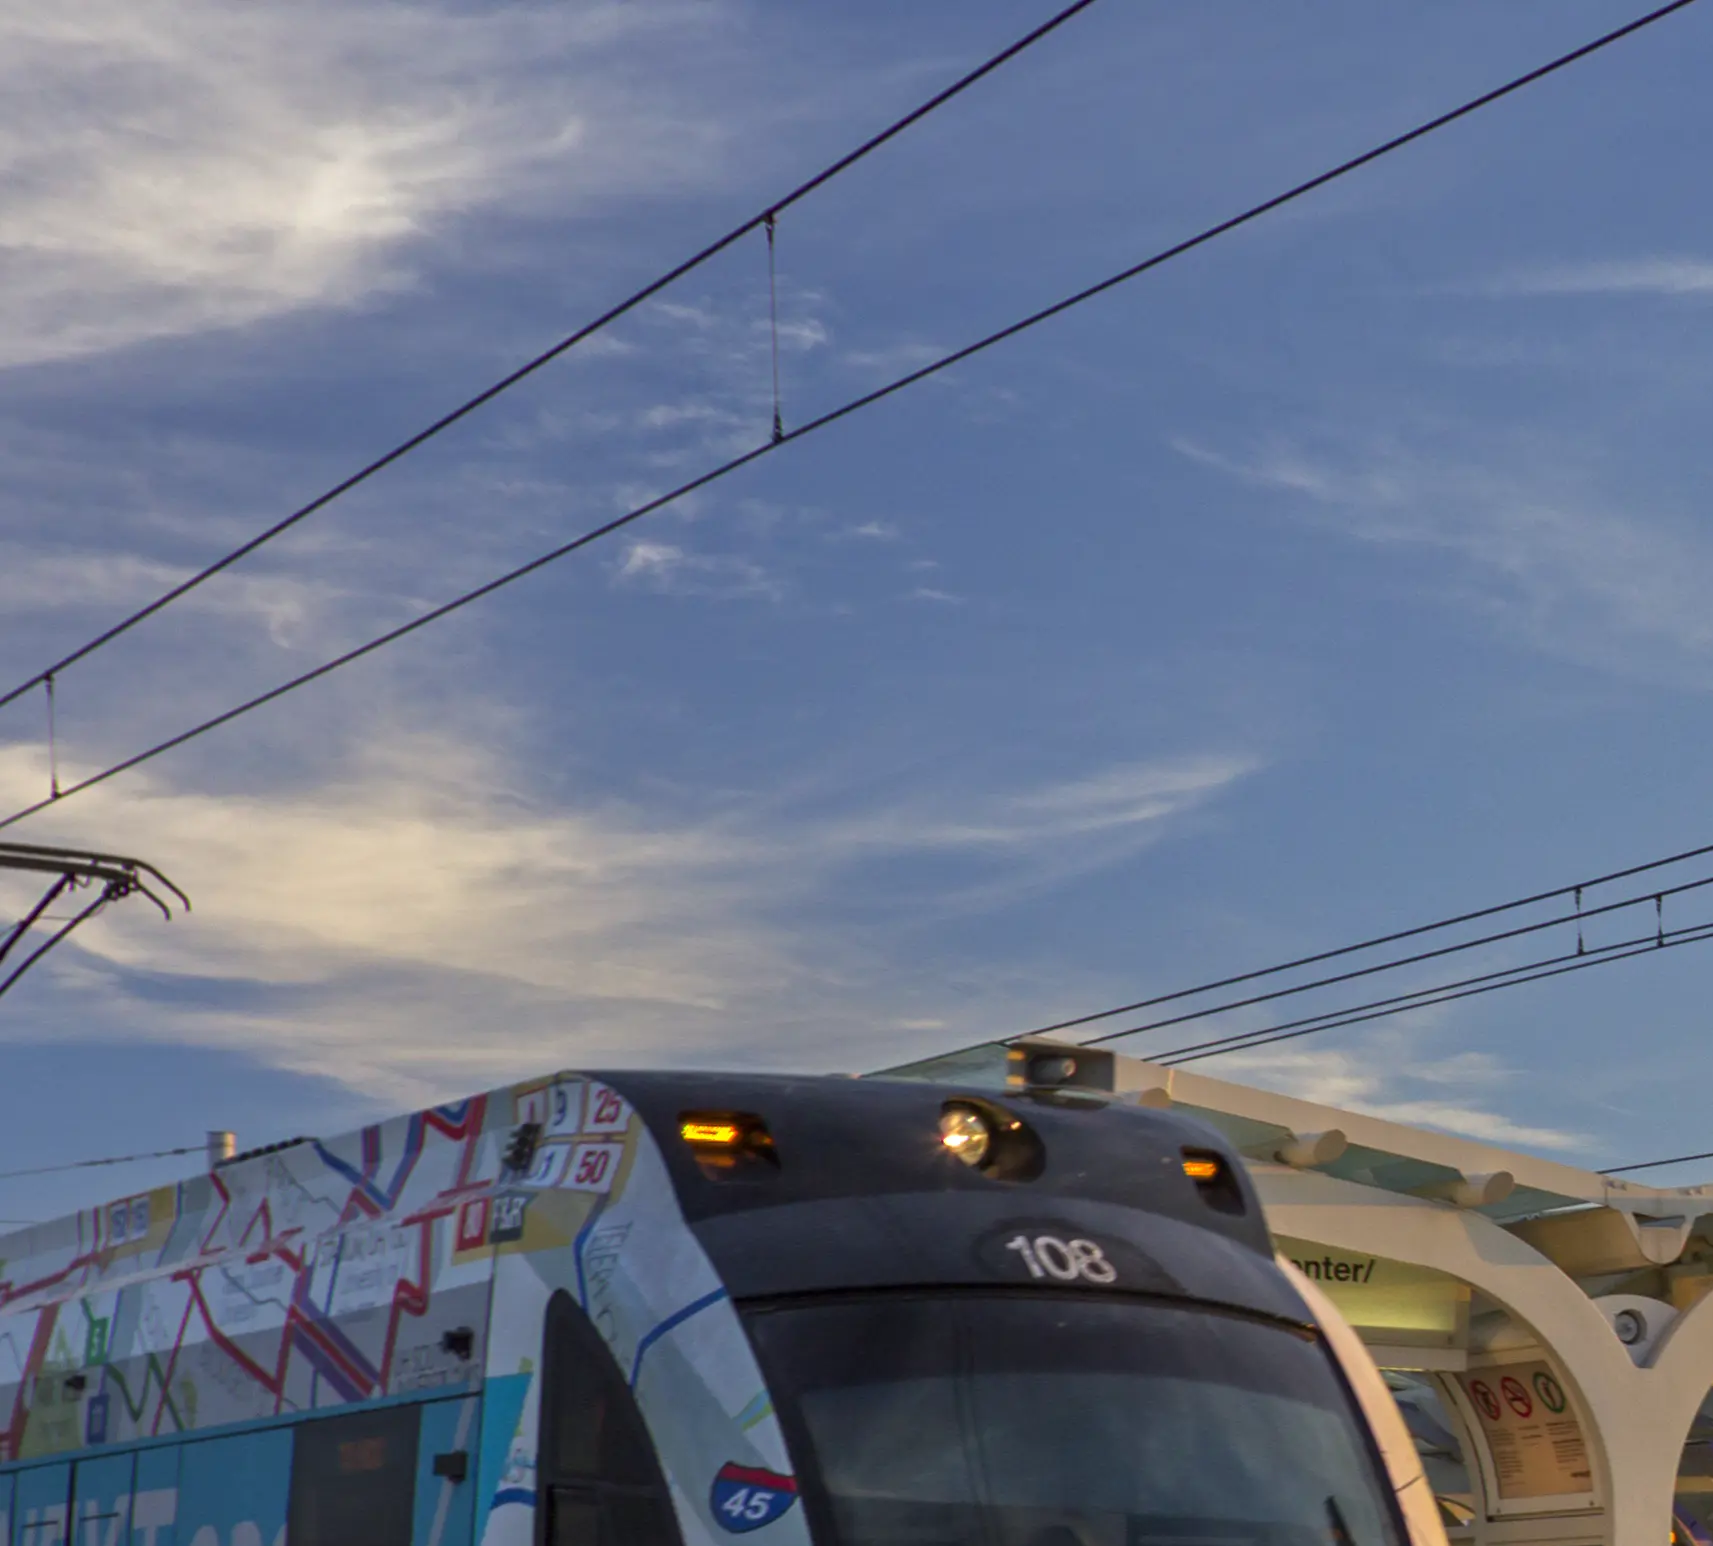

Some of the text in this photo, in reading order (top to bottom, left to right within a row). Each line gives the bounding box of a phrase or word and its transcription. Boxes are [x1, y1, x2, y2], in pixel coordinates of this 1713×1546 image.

[594, 1088, 623, 1125] 25
[575, 1150, 612, 1185] 50
[1005, 1235, 1117, 1283] 108
[1290, 1256, 1377, 1284] nter/
[722, 1487, 776, 1519] 45
